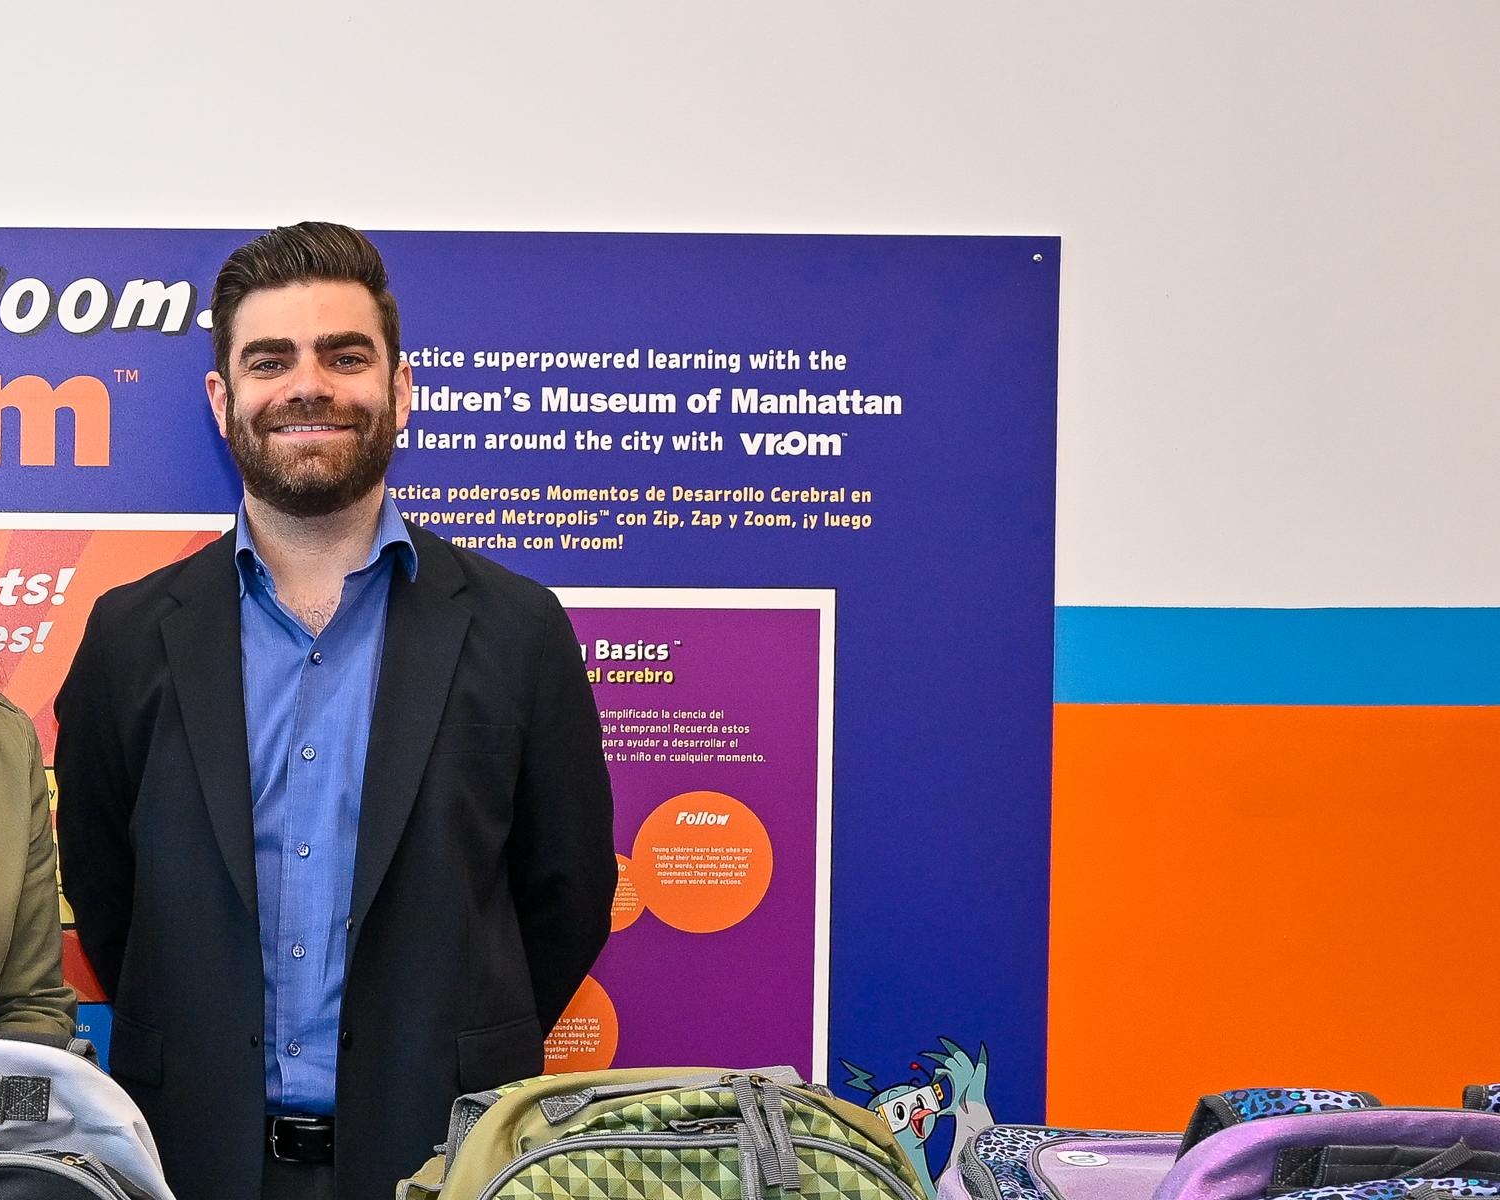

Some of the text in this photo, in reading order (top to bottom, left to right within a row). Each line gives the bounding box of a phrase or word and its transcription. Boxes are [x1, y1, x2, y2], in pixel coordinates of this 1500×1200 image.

[399, 346, 846, 373] actice superpowered learning with the
[410, 385, 901, 414] ildren's Museum of Manhattan
[418, 429, 475, 449] learn
[485, 430, 565, 449] around
[575, 430, 612, 450] the
[621, 431, 663, 454] city
[672, 431, 722, 451] with
[388, 484, 871, 502] actica poderosos Momentos de Desarrollo Cerebral en
[617, 514, 646, 525] con
[653, 510, 684, 528] Zip,
[692, 511, 721, 529] Zap
[729, 515, 737, 528] y
[744, 511, 796, 528] Zoom,
[803, 514, 817, 529] ¡y
[825, 512, 871, 529] luego
[452, 534, 623, 549] marcha con Vroom!
[607, 668, 672, 682] cerebro
[676, 812, 729, 825] Follow
[651, 846, 670, 854] Young
